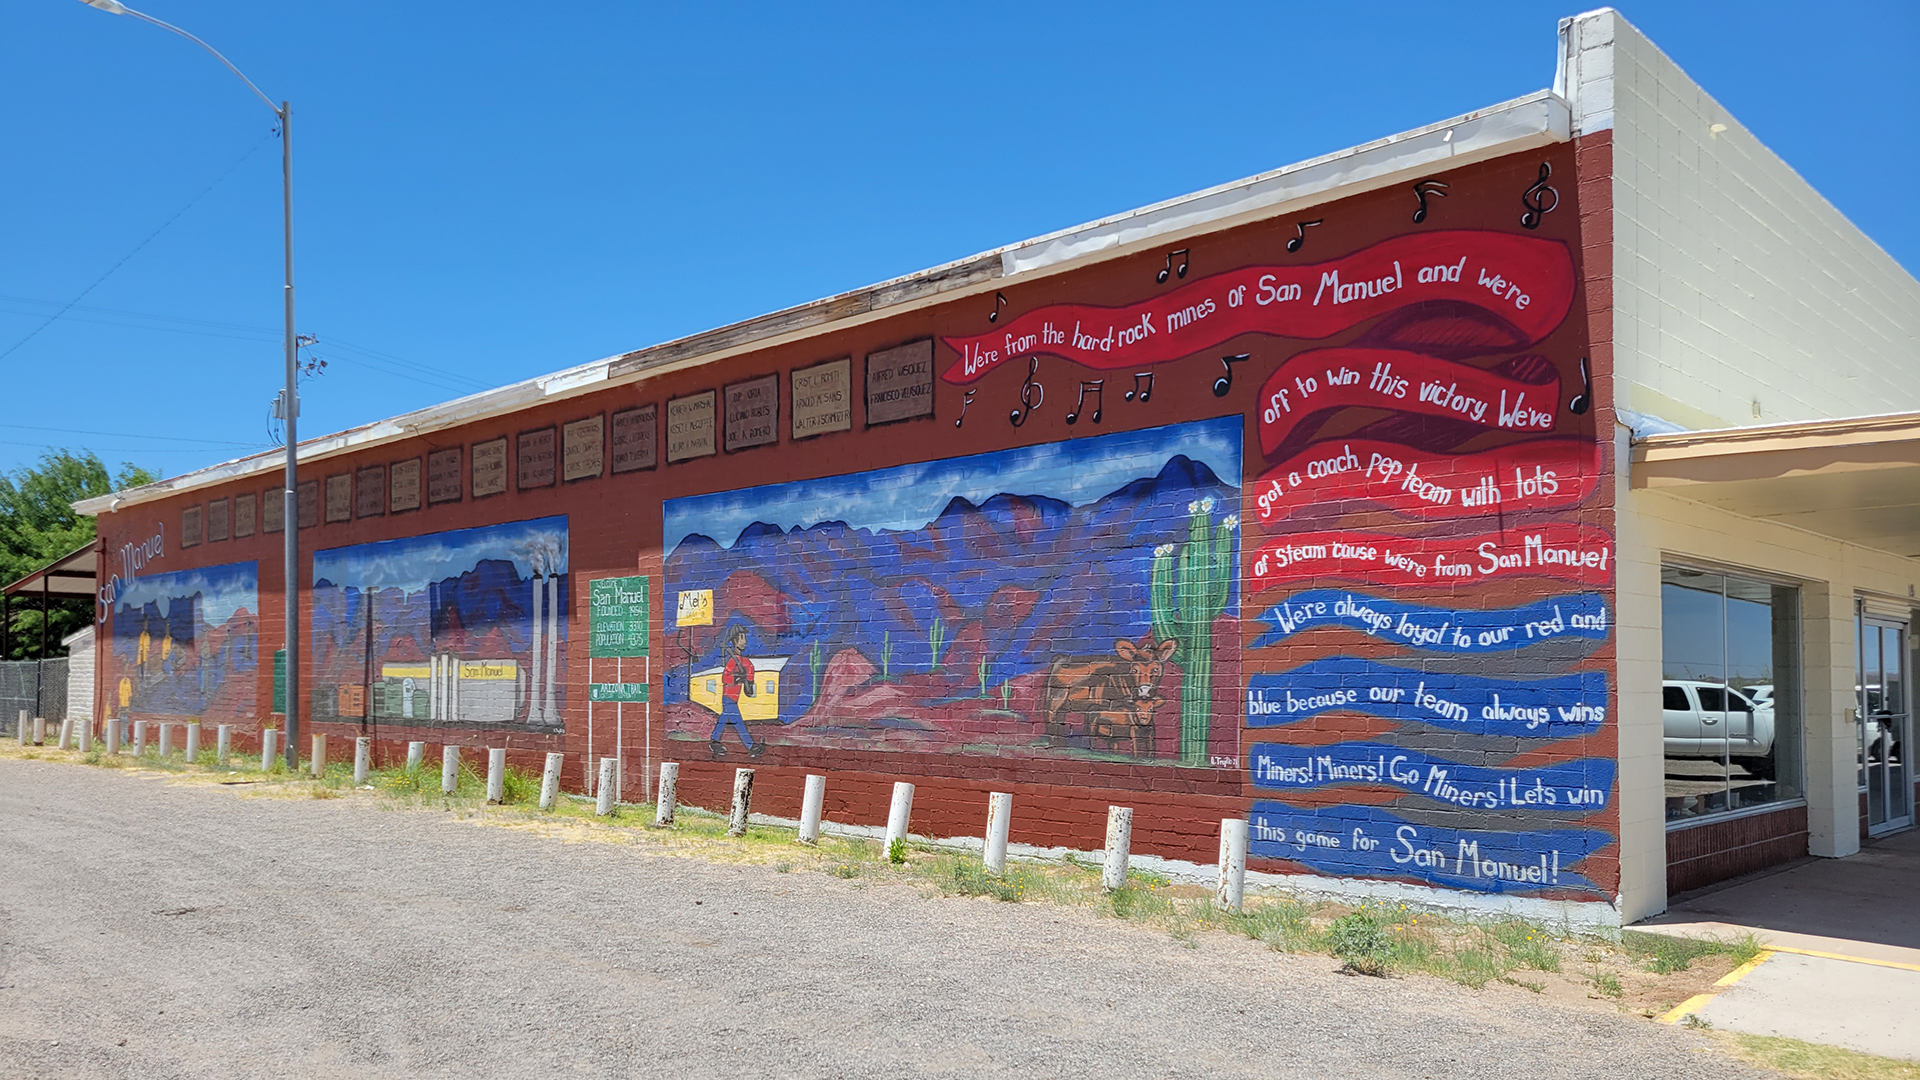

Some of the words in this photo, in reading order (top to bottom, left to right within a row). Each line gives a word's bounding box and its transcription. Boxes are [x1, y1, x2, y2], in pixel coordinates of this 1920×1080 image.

[1005, 333, 1037, 355] from
[1042, 322, 1065, 345] the
[1167, 298, 1216, 333] mines
[1229, 285, 1247, 308] of
[1255, 274, 1302, 306] San
[1313, 260, 1403, 307] Manuel
[1418, 256, 1467, 284] and
[1264, 388, 1291, 424] off
[1295, 376, 1318, 398] to
[1369, 362, 1409, 399] this
[1499, 389, 1552, 428] We've
[1258, 480, 1283, 518] got
[1288, 471, 1302, 487] a
[1401, 463, 1452, 505] team
[1462, 476, 1501, 507] with
[1516, 465, 1559, 499] lots
[99, 573, 121, 624] San
[120, 522, 164, 586] Manuel
[1254, 554, 1269, 577] of
[1435, 554, 1472, 577] from
[1478, 542, 1522, 575] San
[1525, 534, 1608, 571] Manuel
[592, 588, 611, 607] San
[615, 585, 644, 605] Manuel
[679, 592, 708, 610] Mel's
[1334, 594, 1393, 635] always
[1395, 613, 1448, 646] loyal
[1452, 626, 1471, 648] to
[1478, 627, 1514, 645] our
[1526, 605, 1565, 638] red
[1570, 607, 1605, 632] and
[595, 633, 624, 647] POPULATION
[464, 662, 479, 678] San
[481, 661, 504, 677] Manuel
[1249, 690, 1281, 715] blue
[1287, 689, 1357, 713] because
[1369, 687, 1405, 703] our
[1414, 681, 1469, 723] team
[1482, 694, 1550, 730] always
[1557, 702, 1605, 723] wins
[1257, 755, 1313, 784] Miners!
[1317, 755, 1384, 782] Miners!
[1390, 755, 1419, 786] Go
[1424, 765, 1505, 809] Miners!
[1567, 785, 1604, 805] win
[1255, 817, 1286, 841] this
[1295, 829, 1340, 850] game
[1353, 828, 1380, 851] for
[1390, 825, 1445, 869] San
[1456, 839, 1559, 885] Manuel!
